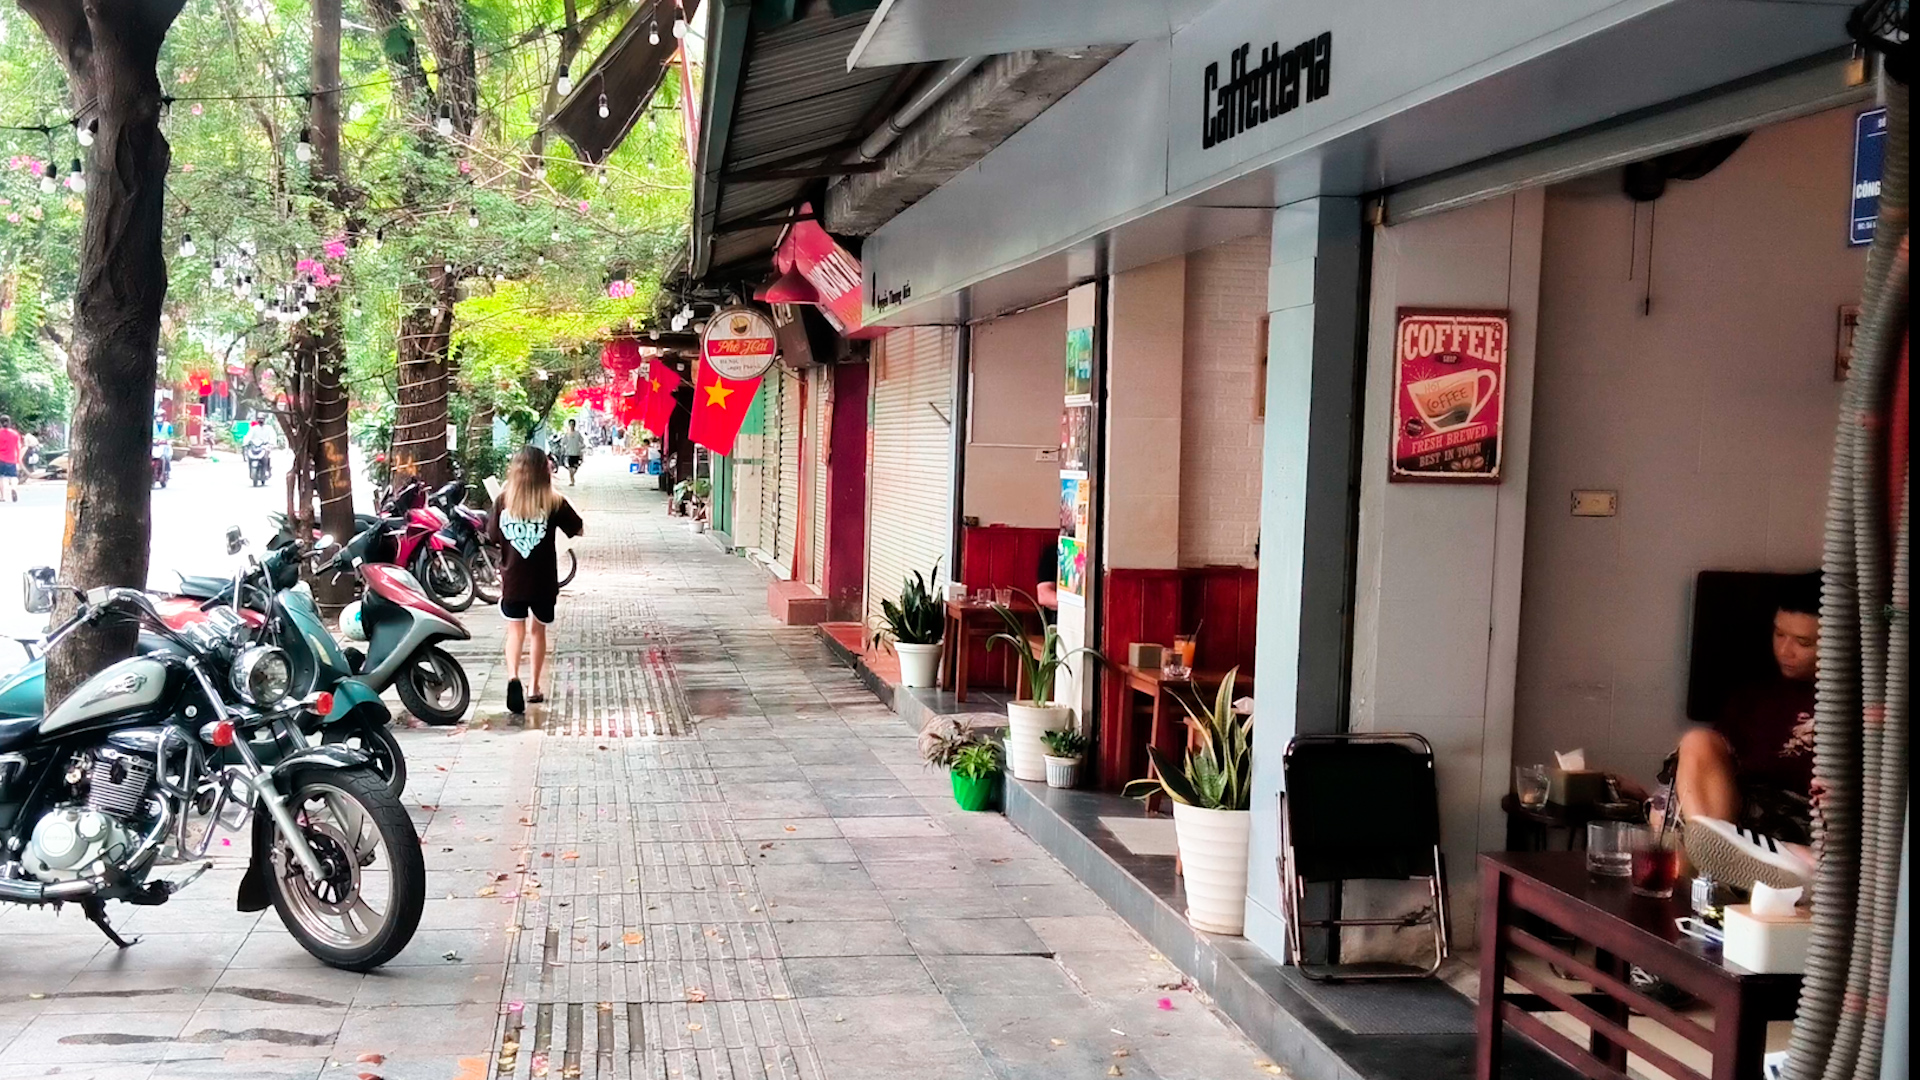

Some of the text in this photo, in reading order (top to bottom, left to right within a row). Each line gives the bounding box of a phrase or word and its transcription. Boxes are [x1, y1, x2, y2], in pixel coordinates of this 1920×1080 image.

[1203, 31, 1332, 150] Caffetteria
[1404, 323, 1500, 363] COFFEE
[1427, 387, 1469, 413] COFFEE
[1411, 425, 1488, 455] FRESH BREWED
[1419, 442, 1482, 468] BEST IN TOWN
